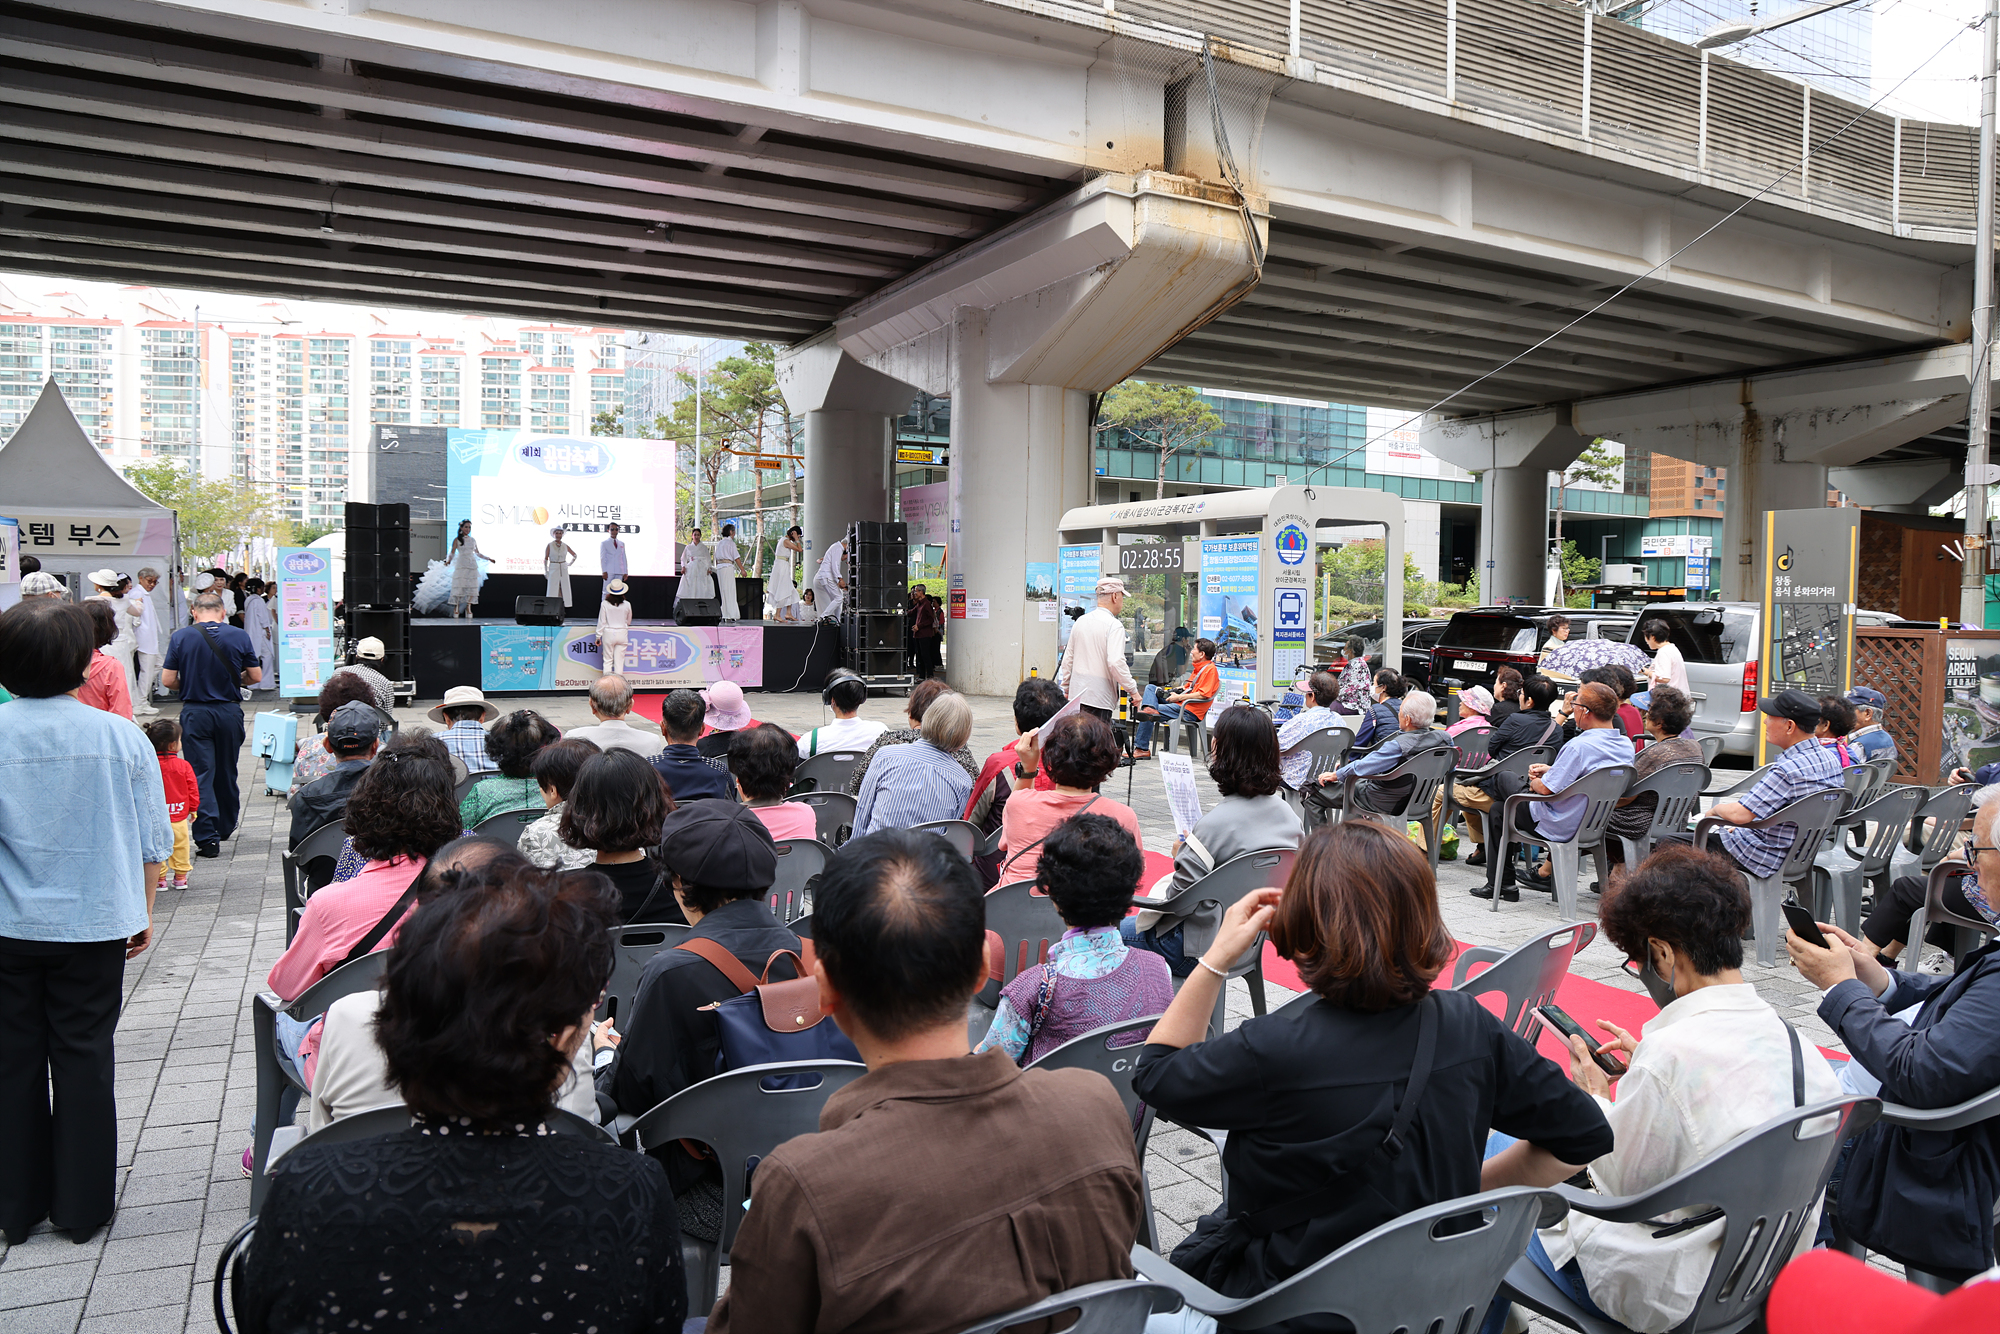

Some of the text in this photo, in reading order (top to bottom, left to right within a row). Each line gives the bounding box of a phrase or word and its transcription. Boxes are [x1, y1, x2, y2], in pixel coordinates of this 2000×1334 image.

[1116, 503, 1196, 519] 서울시립상이군경복지관
[68, 524, 121, 546] 부스
[1121, 548, 1181, 569] 02:28:55
[1775, 576, 1792, 586] 창동
[1774, 587, 1791, 597] 음식
[571, 641, 598, 653] 제1회
[1948, 647, 1977, 660] SEOUL
[1947, 662, 1977, 675] ARENA
